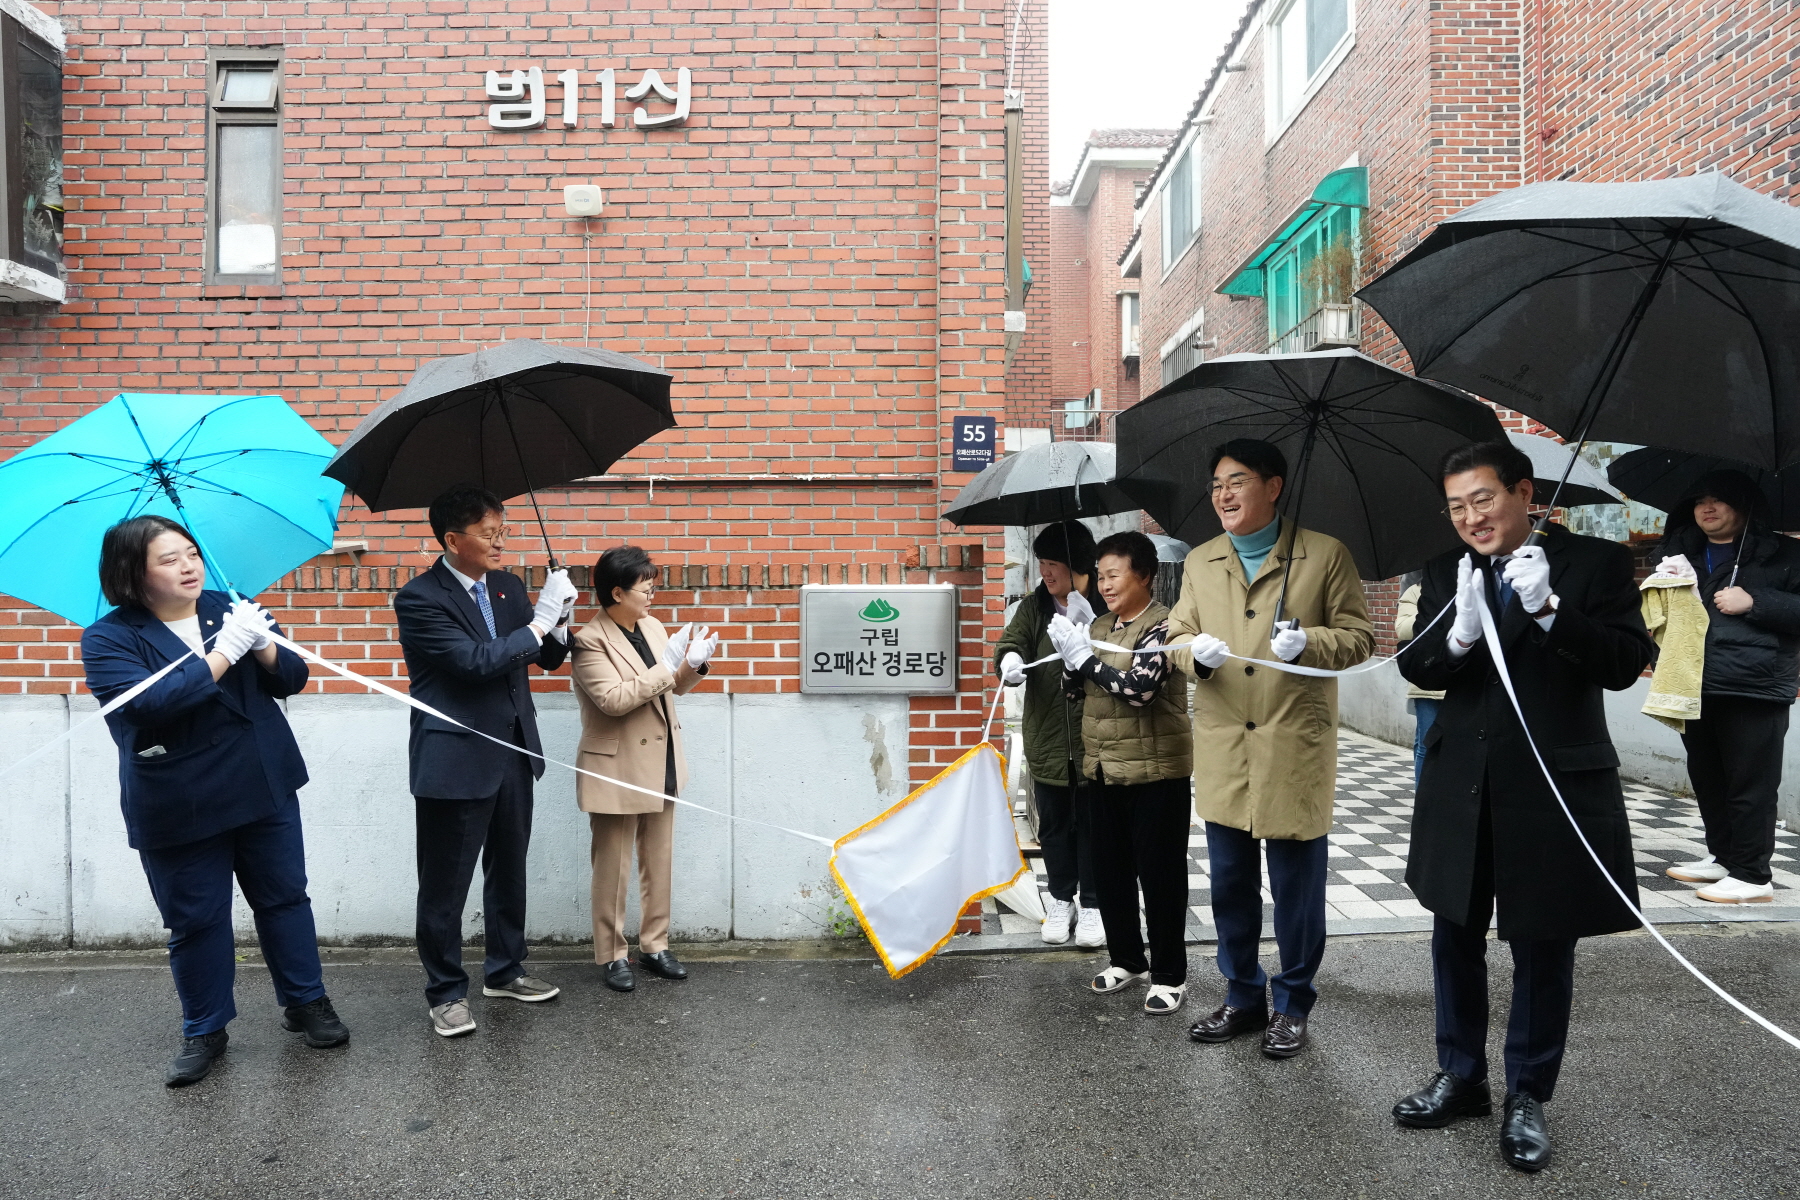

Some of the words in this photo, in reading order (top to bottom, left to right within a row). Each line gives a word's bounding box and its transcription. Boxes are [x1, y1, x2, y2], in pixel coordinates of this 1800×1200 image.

[963, 424, 986, 442] 55
[860, 628, 899, 646] 구립
[811, 651, 877, 676] 오패산
[882, 651, 947, 677] 경로당
